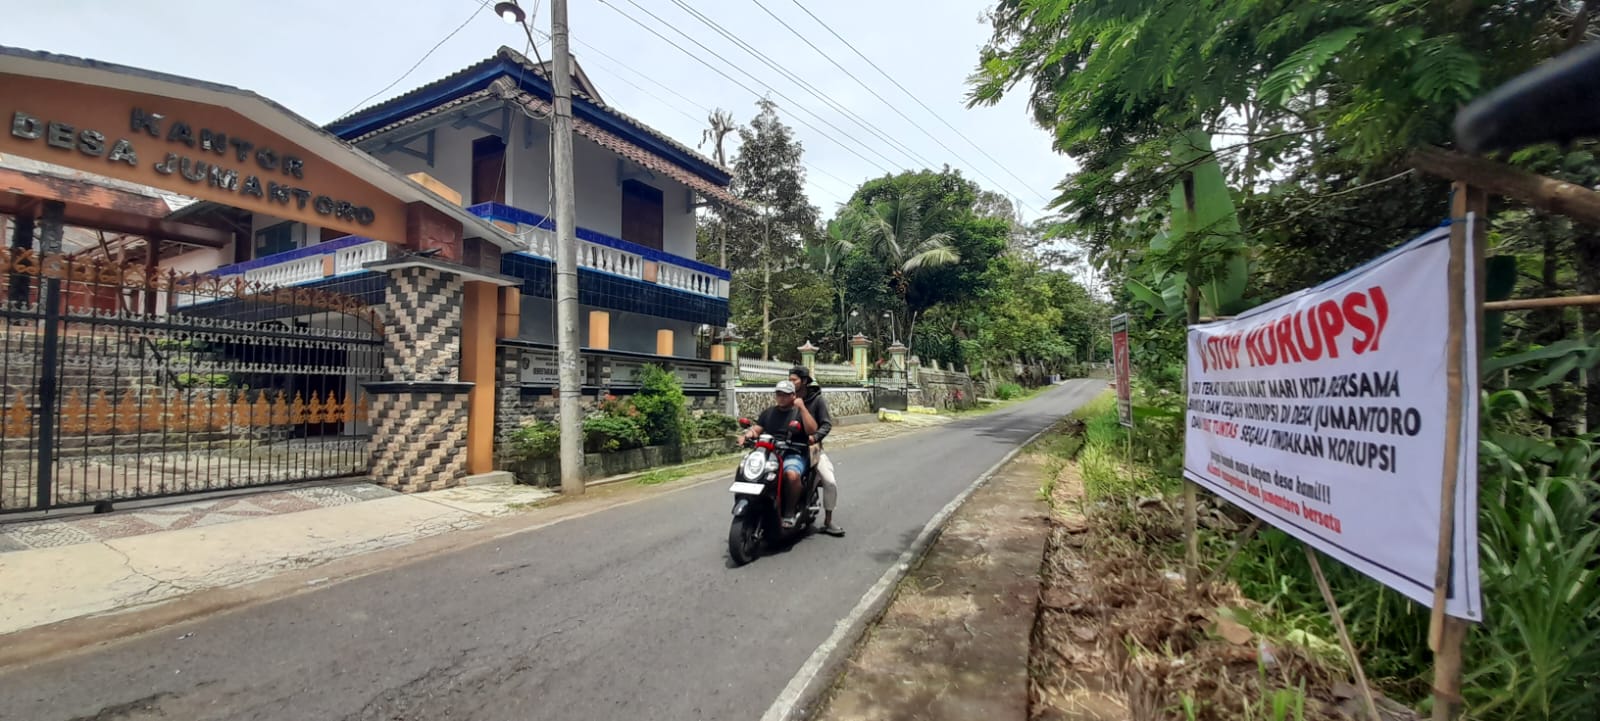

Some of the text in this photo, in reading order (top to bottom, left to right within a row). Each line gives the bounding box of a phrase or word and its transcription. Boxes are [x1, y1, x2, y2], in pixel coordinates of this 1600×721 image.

[129, 107, 306, 180] KANTOR
[11, 111, 376, 226] DESA JUMANTORO
[1207, 331, 1242, 371] STOP
[1245, 286, 1388, 368] KORUPSI
[1267, 379, 1299, 399] MARI
[1299, 377, 1325, 399] KITA
[1326, 370, 1400, 398] BERSAMA
[1243, 403, 1279, 423] KORUPSI
[1280, 404, 1291, 425] DI
[1290, 404, 1313, 427] DESA
[1314, 404, 1422, 437] JUMANTORO
[1269, 429, 1325, 459] TINDAKAN
[1327, 436, 1396, 474] KORUPSI
[1274, 469, 1294, 491] desa
[1302, 500, 1342, 534] bersatu
